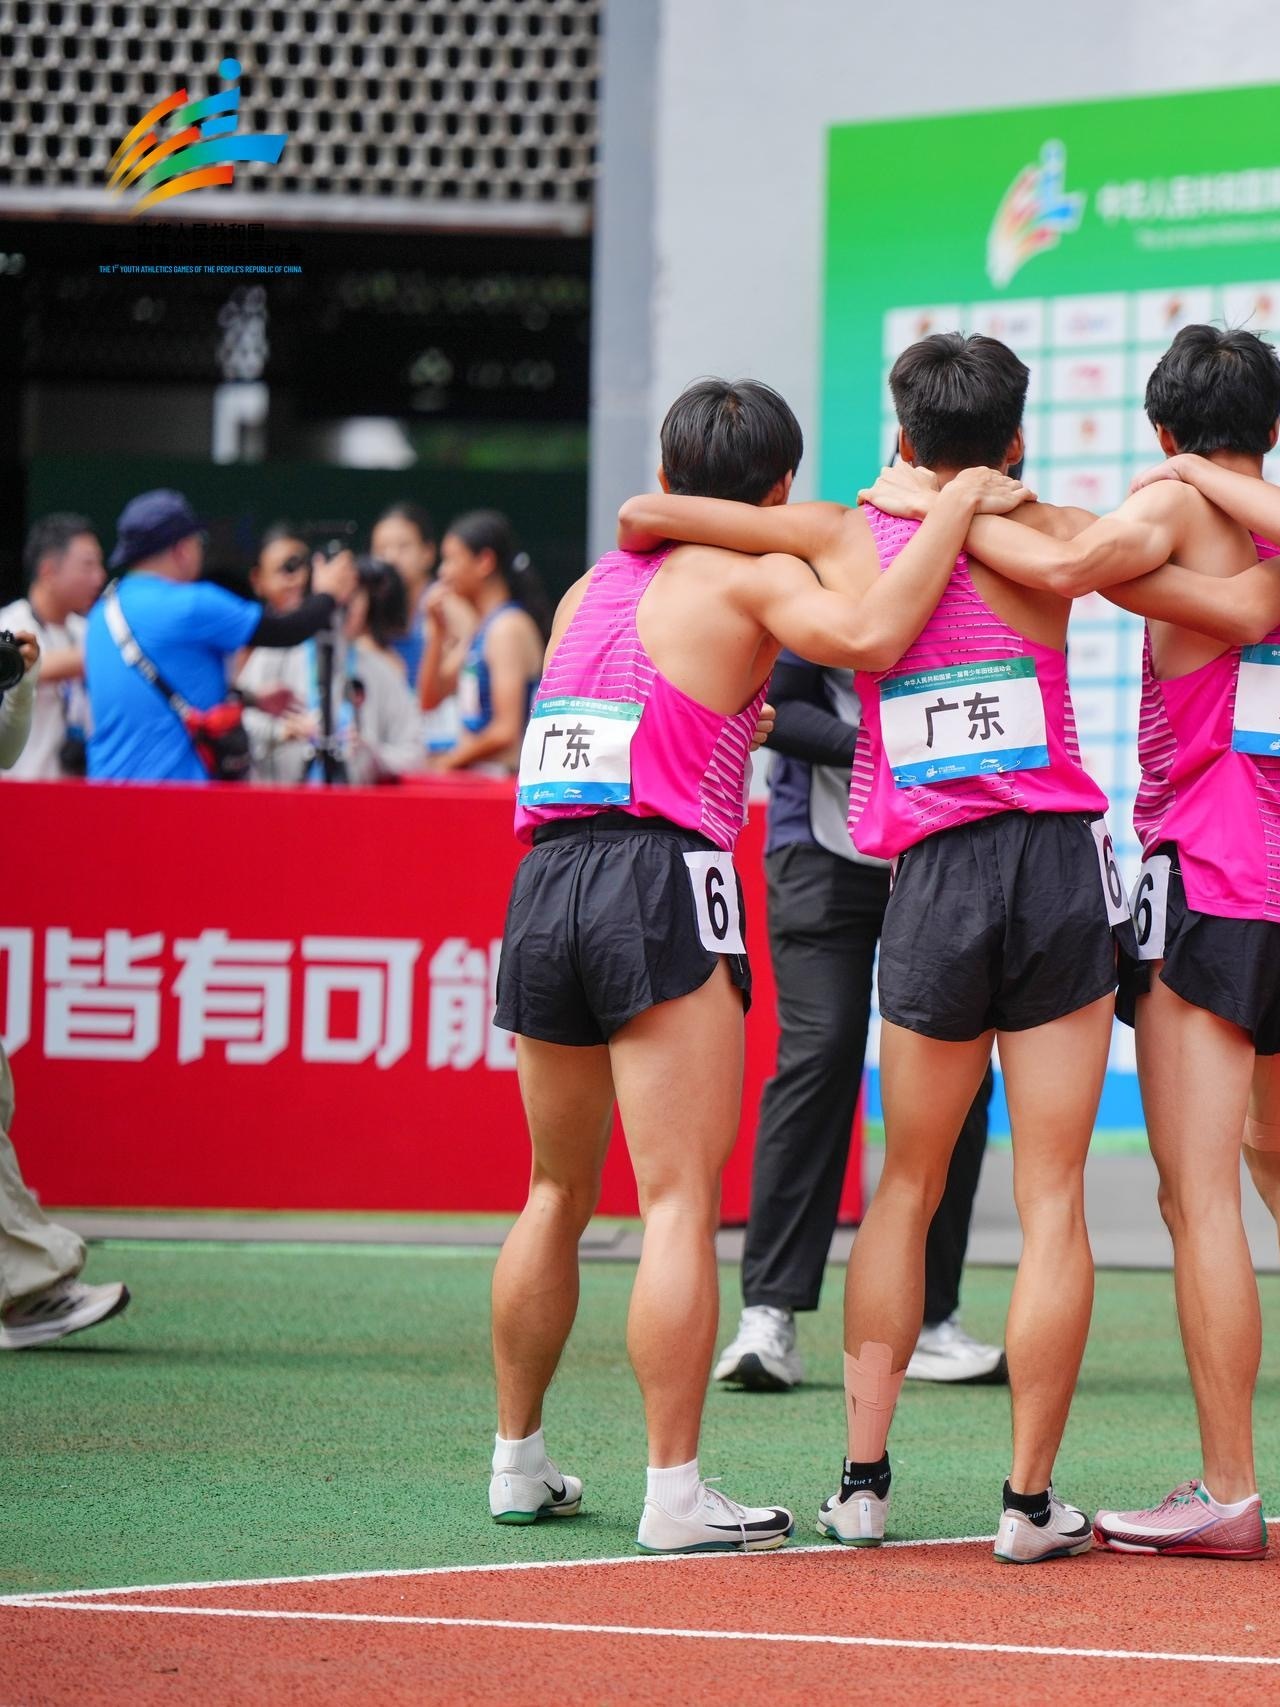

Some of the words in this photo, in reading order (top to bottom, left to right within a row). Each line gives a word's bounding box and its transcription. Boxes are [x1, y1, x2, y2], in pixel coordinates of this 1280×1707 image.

[538, 722, 595, 772] 广东
[924, 691, 1005, 749] 广东
[704, 866, 729, 942] 6
[1101, 833, 1123, 910] 6
[1134, 873, 1154, 947] 6
[0, 925, 519, 1071] 皆有可能
